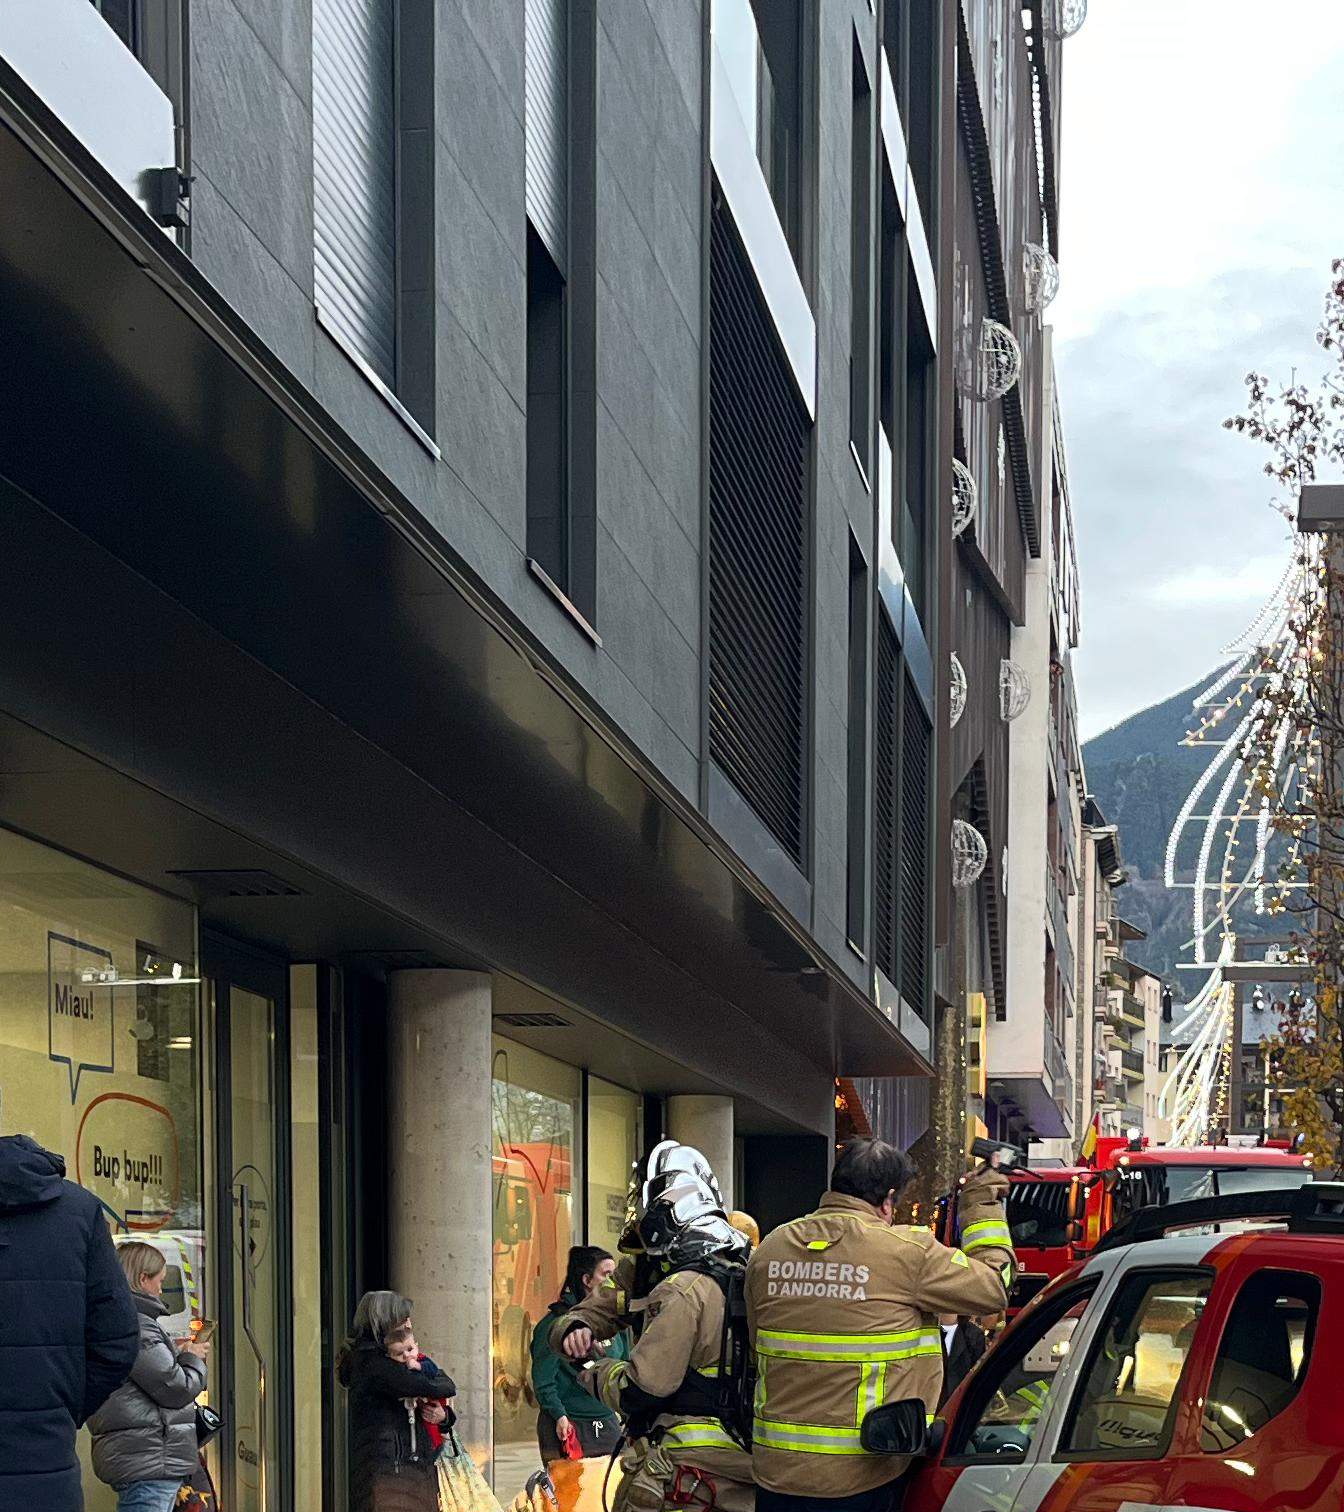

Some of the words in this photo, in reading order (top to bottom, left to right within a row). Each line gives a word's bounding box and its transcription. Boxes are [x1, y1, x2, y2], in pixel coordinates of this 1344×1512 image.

[55, 982, 94, 1020] Miau!
[94, 1145, 120, 1187] Bup
[124, 1149, 163, 1190] bup!!!
[767, 1260, 870, 1284] BOMBERS
[767, 1281, 867, 1301] D'ANDORRA
